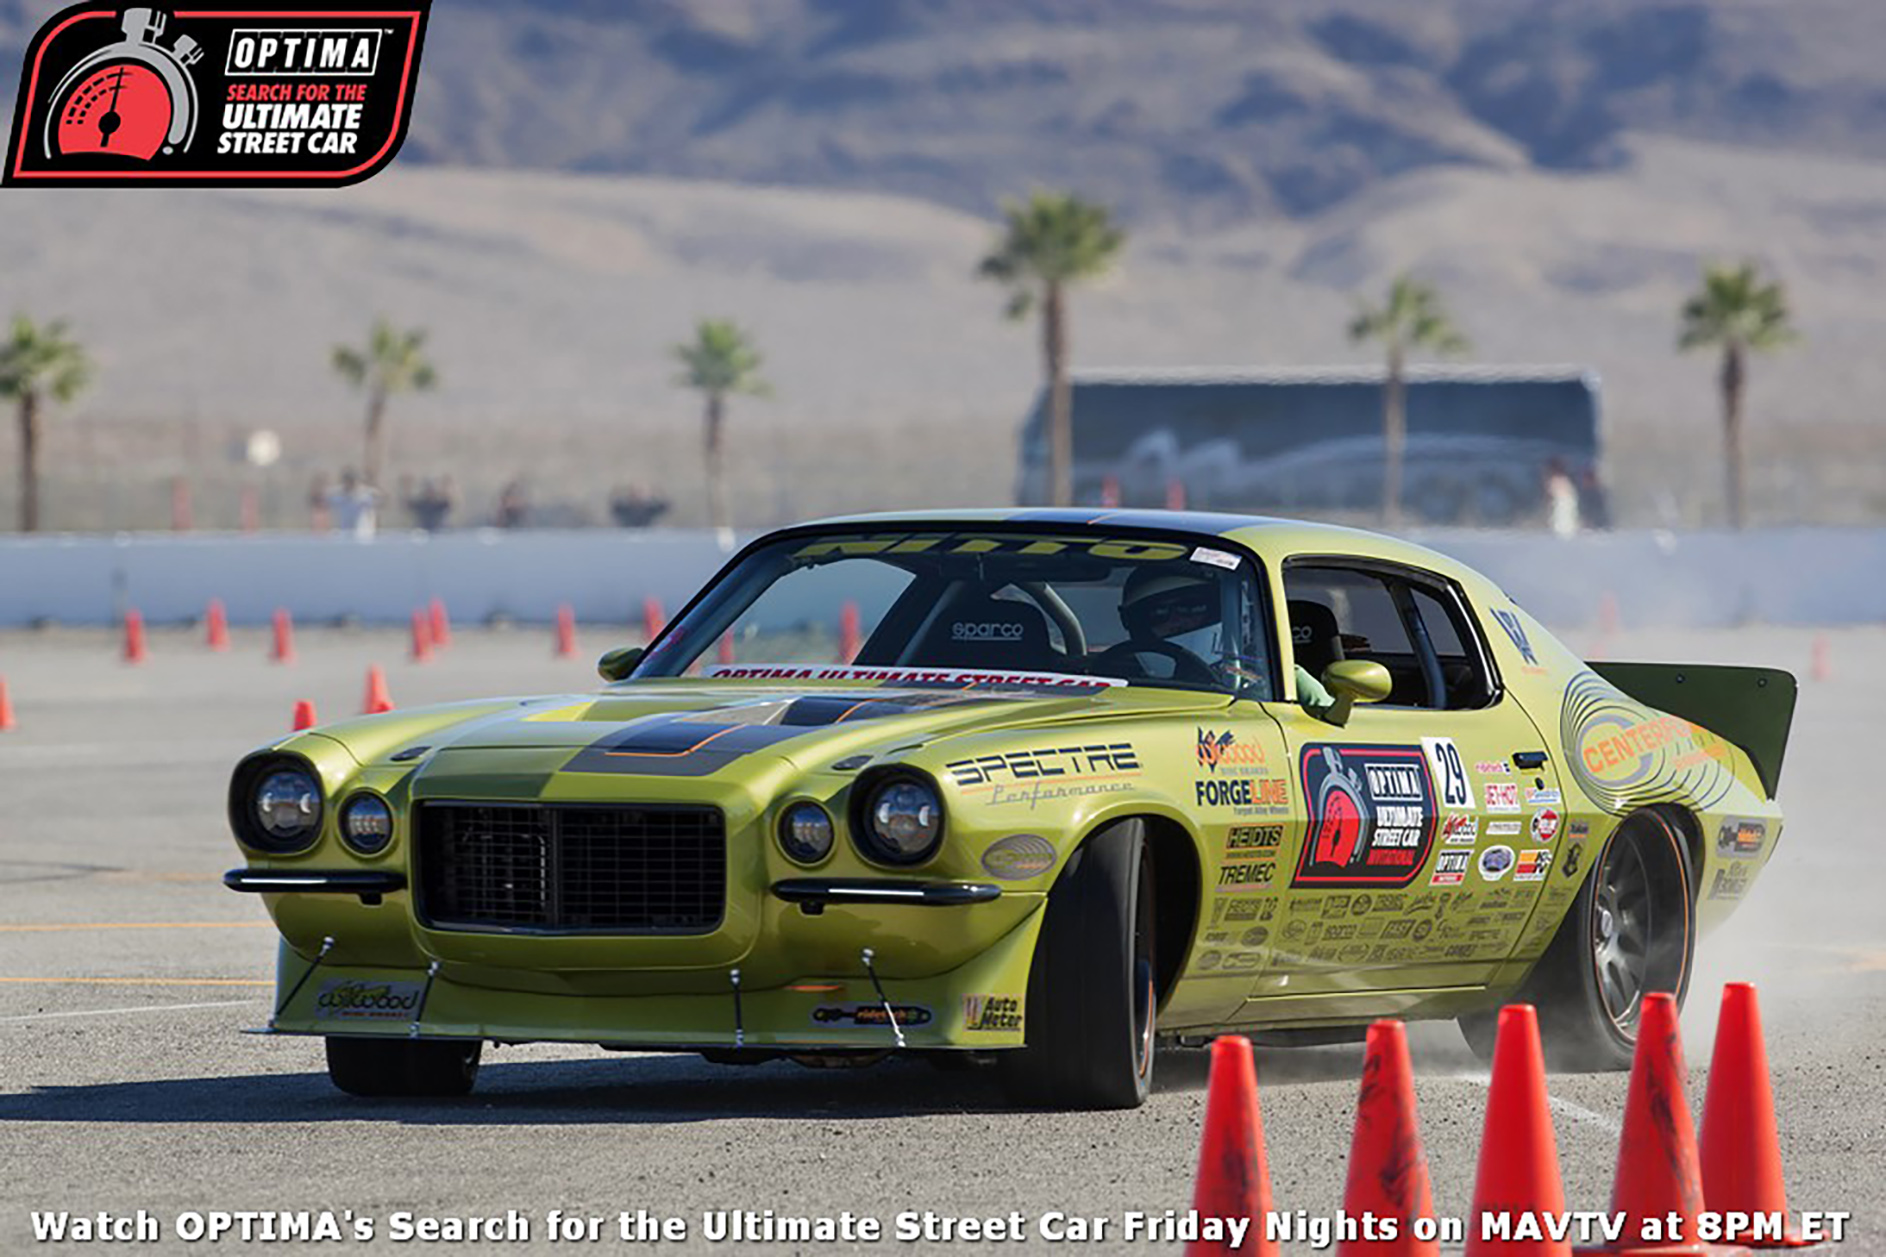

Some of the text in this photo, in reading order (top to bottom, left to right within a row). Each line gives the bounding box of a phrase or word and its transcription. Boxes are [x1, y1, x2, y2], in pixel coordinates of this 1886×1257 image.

[946, 744, 1140, 786] SPECTRE
[1435, 743, 1467, 805] 29
[1195, 779, 1289, 806] FORGELINE
[1368, 770, 1420, 794] OPTIMA
[985, 780, 1135, 809] Performance
[1376, 806, 1423, 827] ULTIMATE
[1228, 827, 1282, 848] HEIDTS
[1372, 828, 1420, 847] STREET CAR
[1218, 863, 1276, 885] TREMEC
[986, 997, 1018, 1013] Auto
[982, 1013, 1023, 1028] Meter
